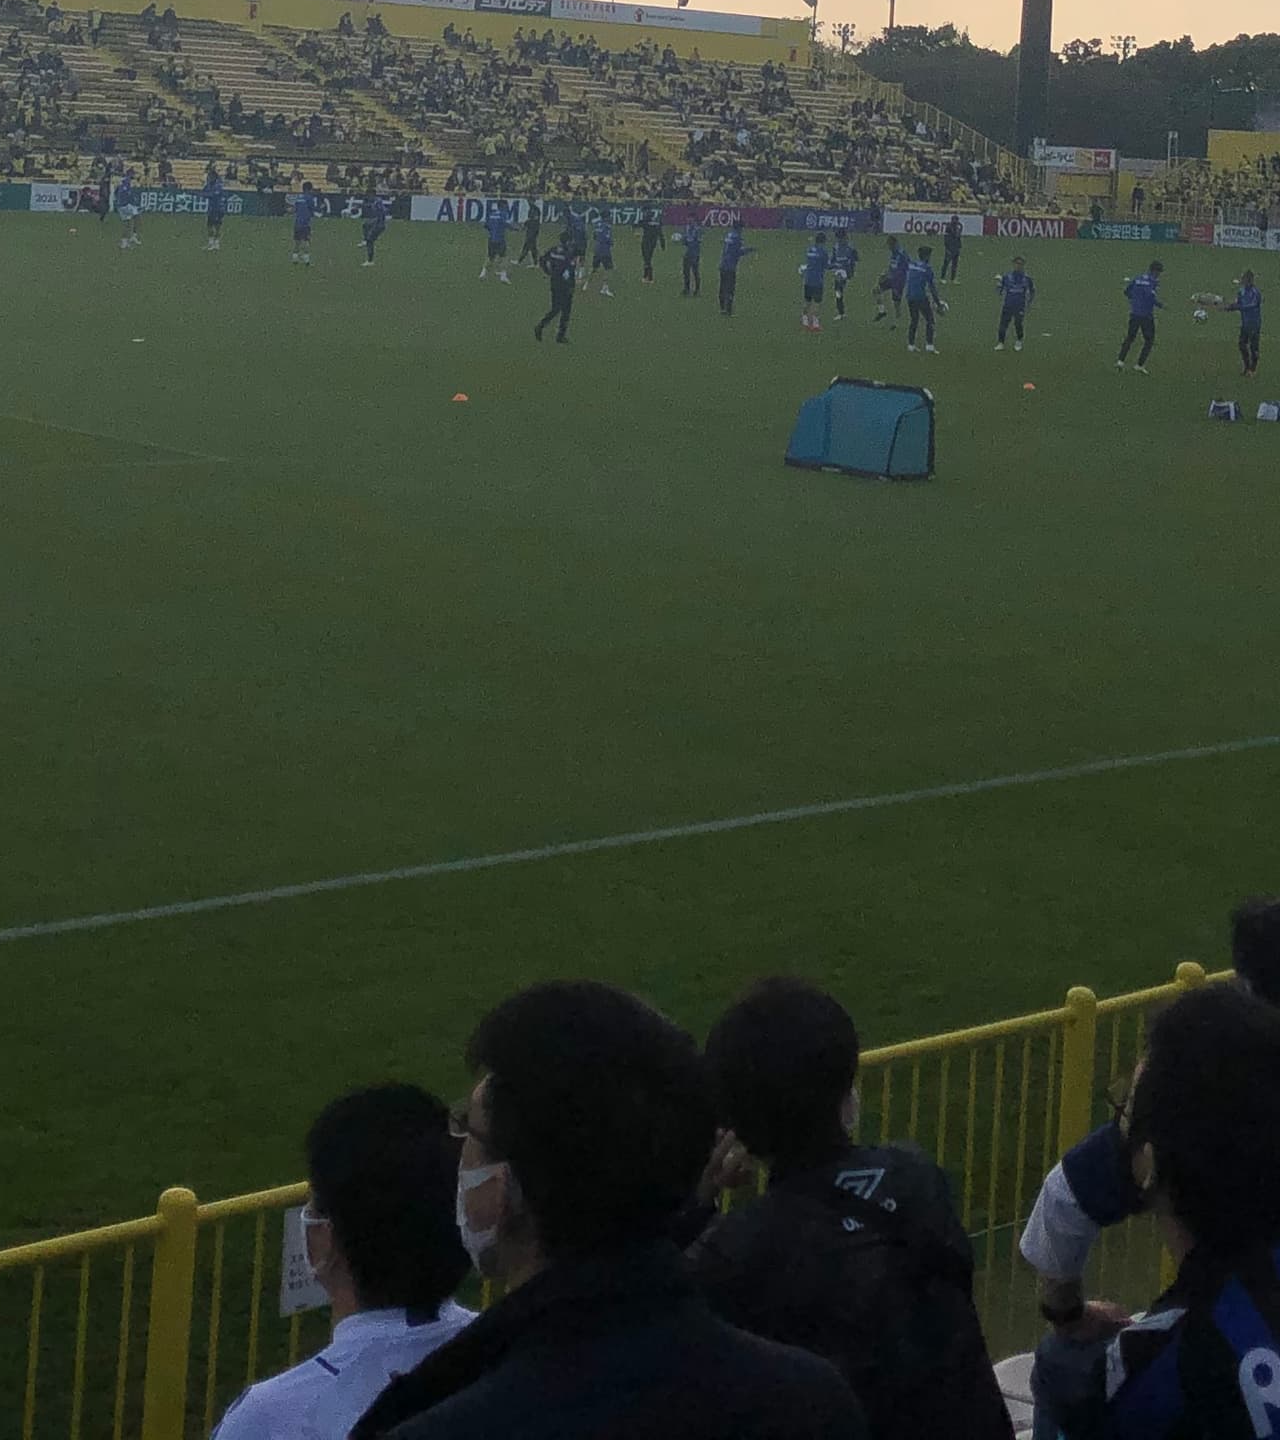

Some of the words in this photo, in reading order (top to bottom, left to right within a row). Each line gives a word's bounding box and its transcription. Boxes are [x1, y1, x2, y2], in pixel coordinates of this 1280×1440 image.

[140, 191, 243, 213] 明治安田命
[997, 217, 1065, 239] KONAMI
